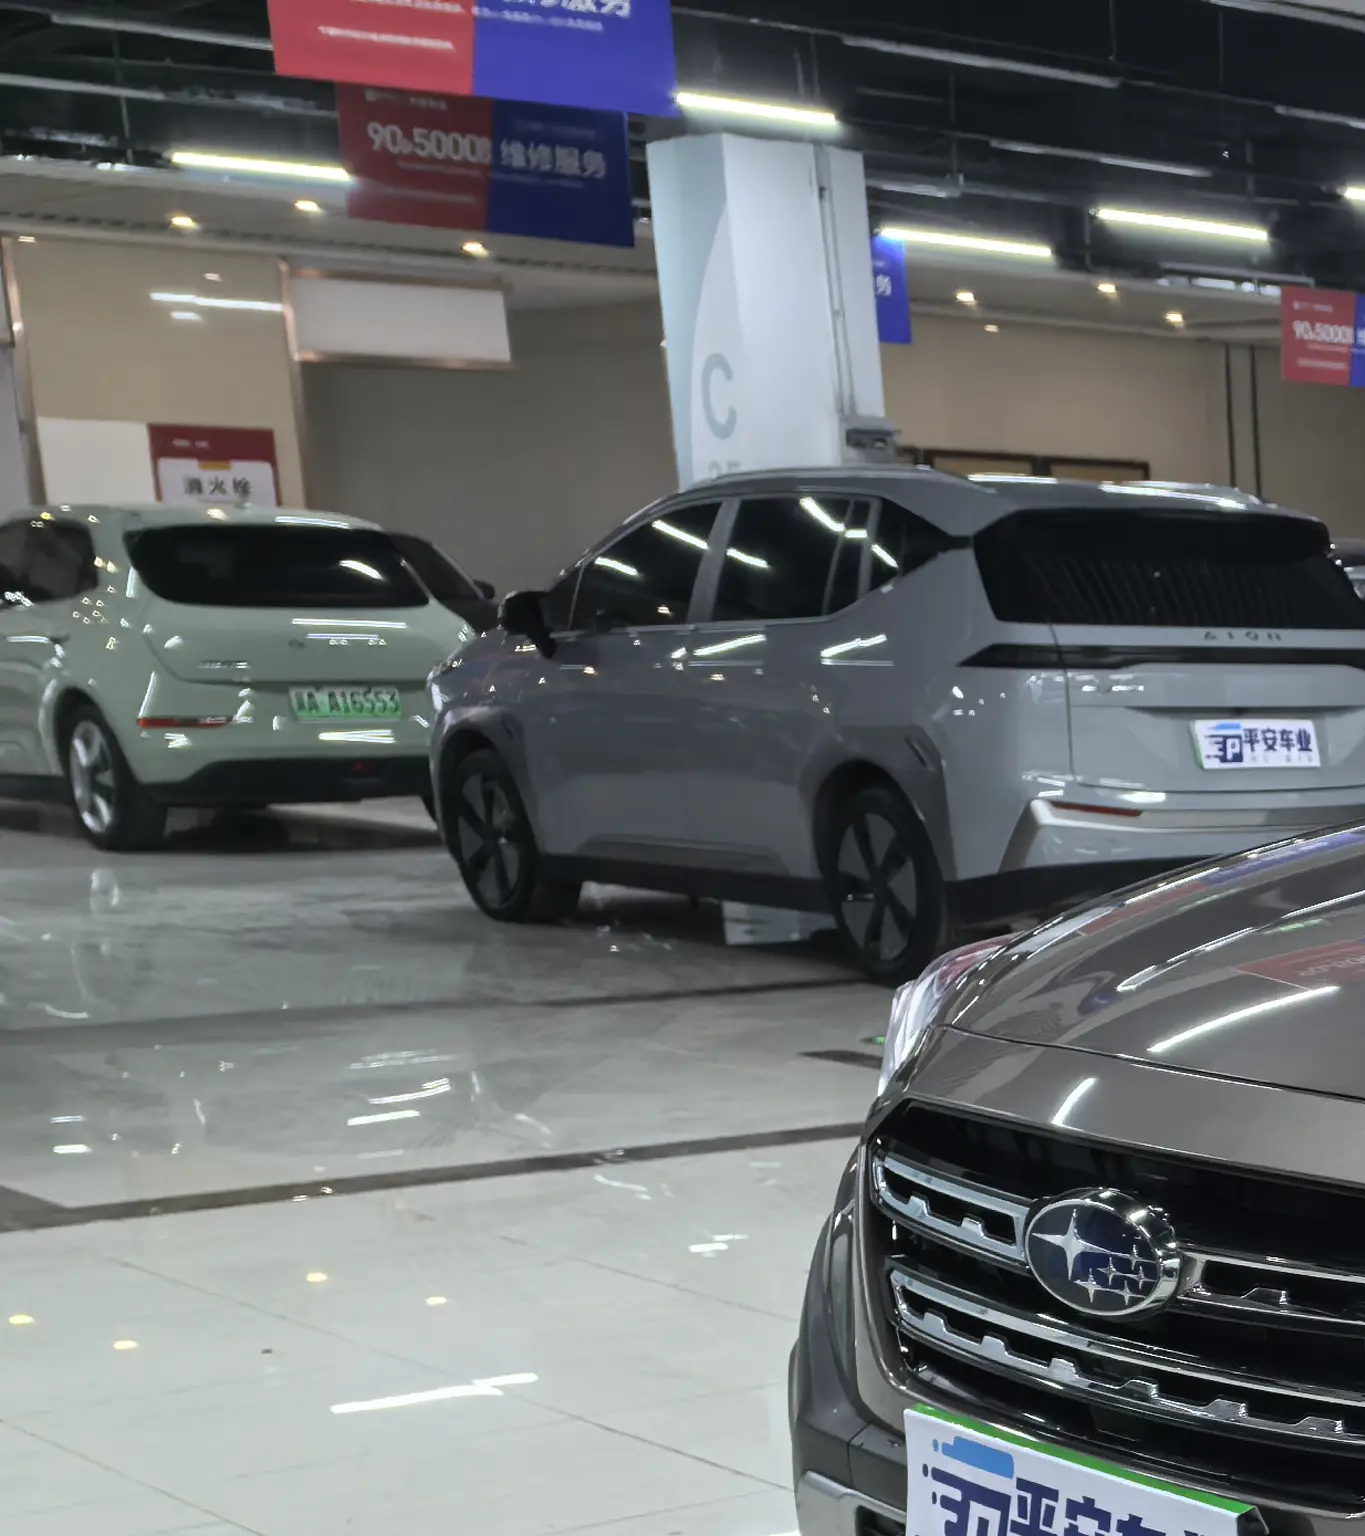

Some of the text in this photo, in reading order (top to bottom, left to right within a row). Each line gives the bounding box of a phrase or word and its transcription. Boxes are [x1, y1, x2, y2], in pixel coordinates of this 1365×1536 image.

[701, 352, 737, 441] C
[1243, 728, 1313, 752] 平安车业
